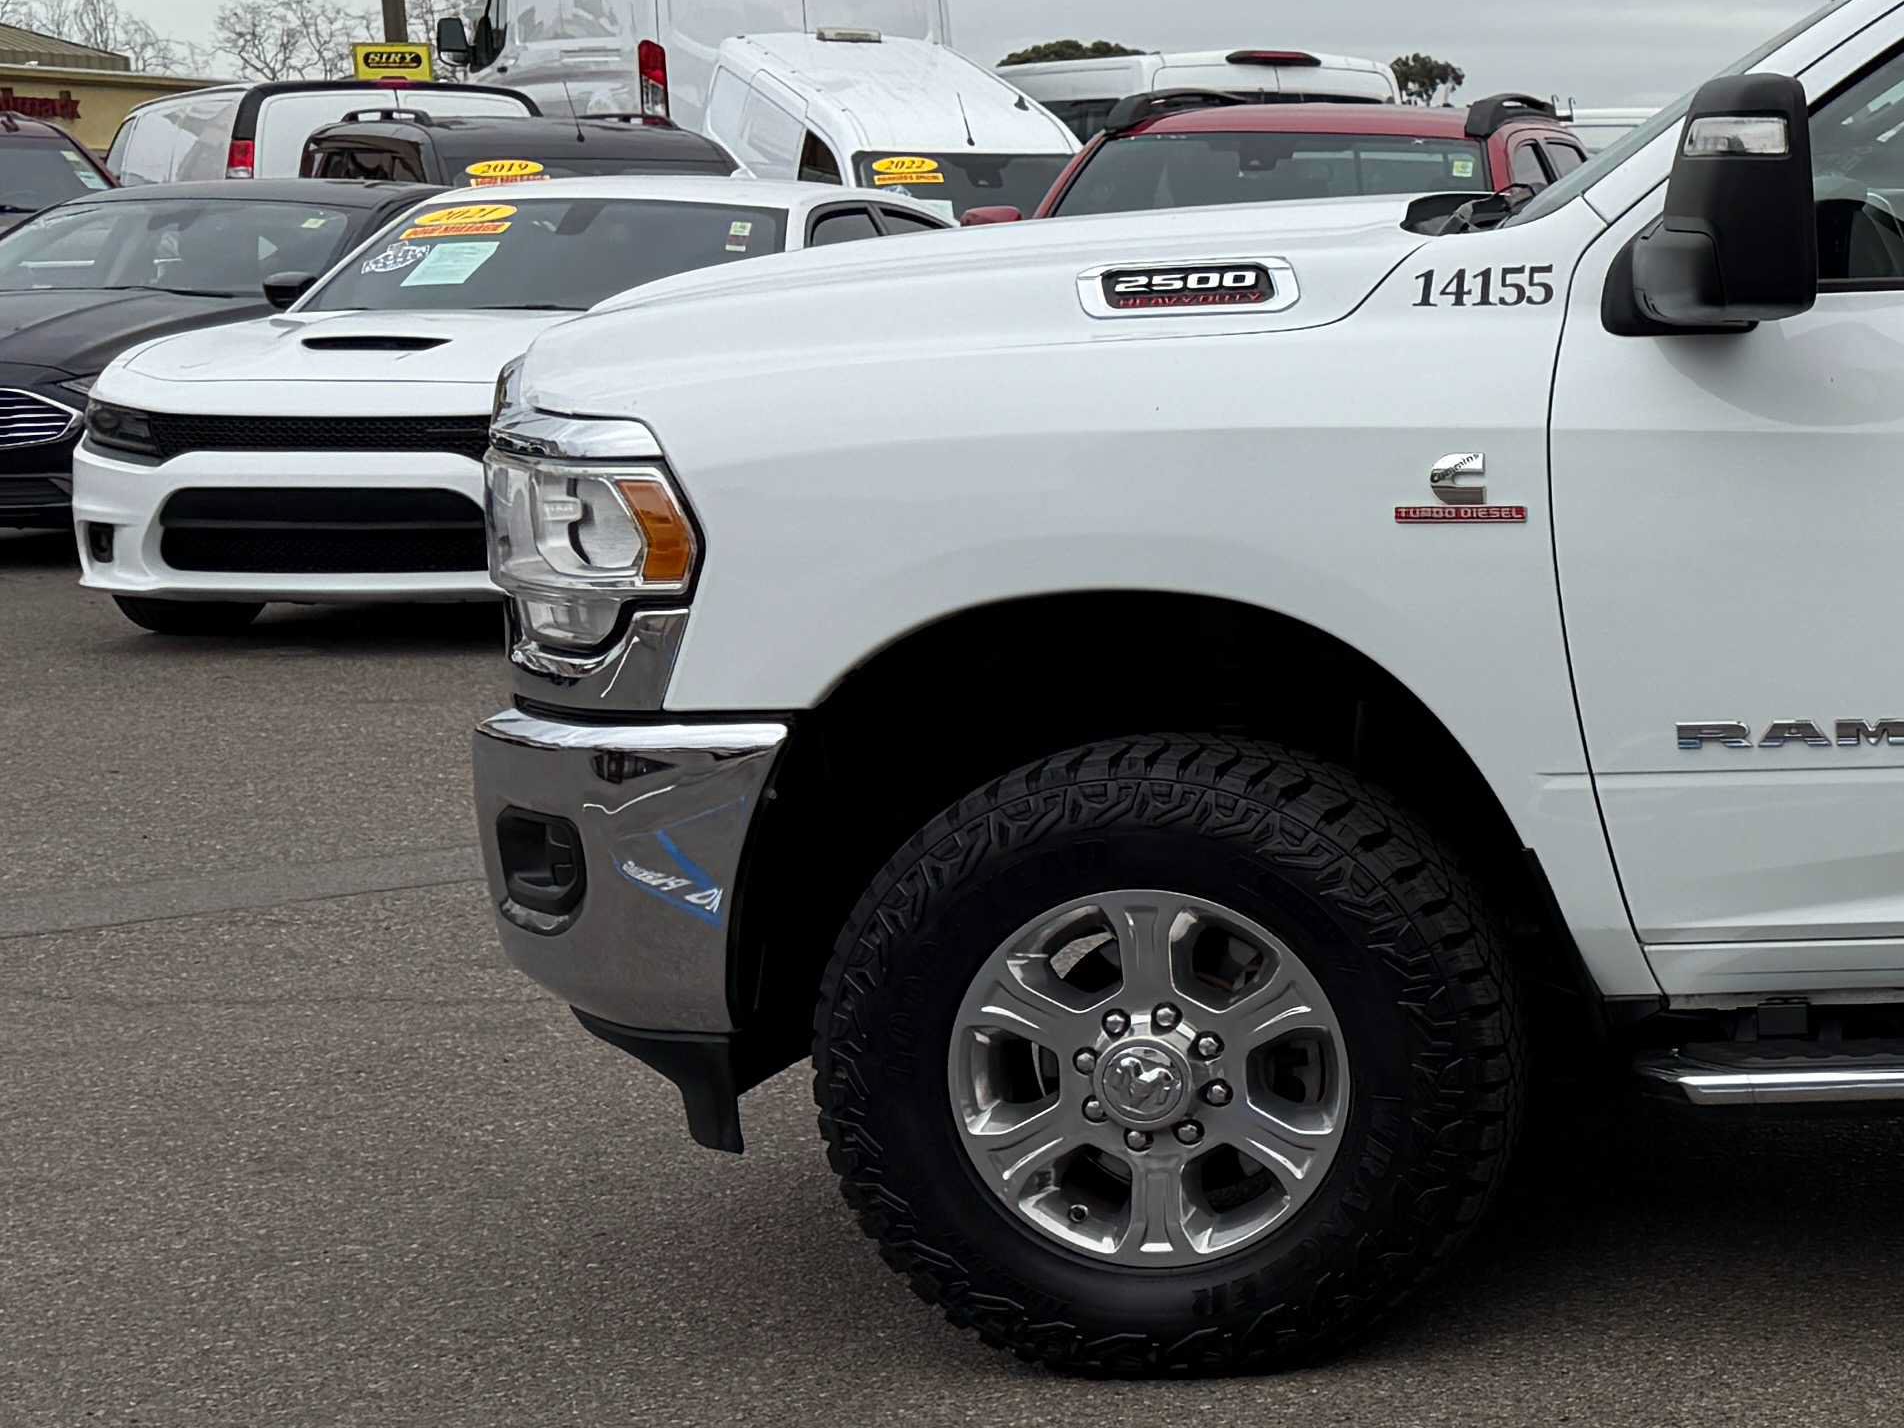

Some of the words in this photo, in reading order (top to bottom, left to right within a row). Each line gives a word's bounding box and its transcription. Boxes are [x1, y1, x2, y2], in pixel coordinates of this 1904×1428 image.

[368, 53, 416, 63] SIRY
[480, 162, 529, 174] 2019
[884, 159, 926, 170] 2022
[1115, 271, 1256, 292] 2500
[1412, 264, 1554, 307] 14155
[1398, 507, 1456, 519] TURBO
[1459, 507, 1524, 519] DIESEL
